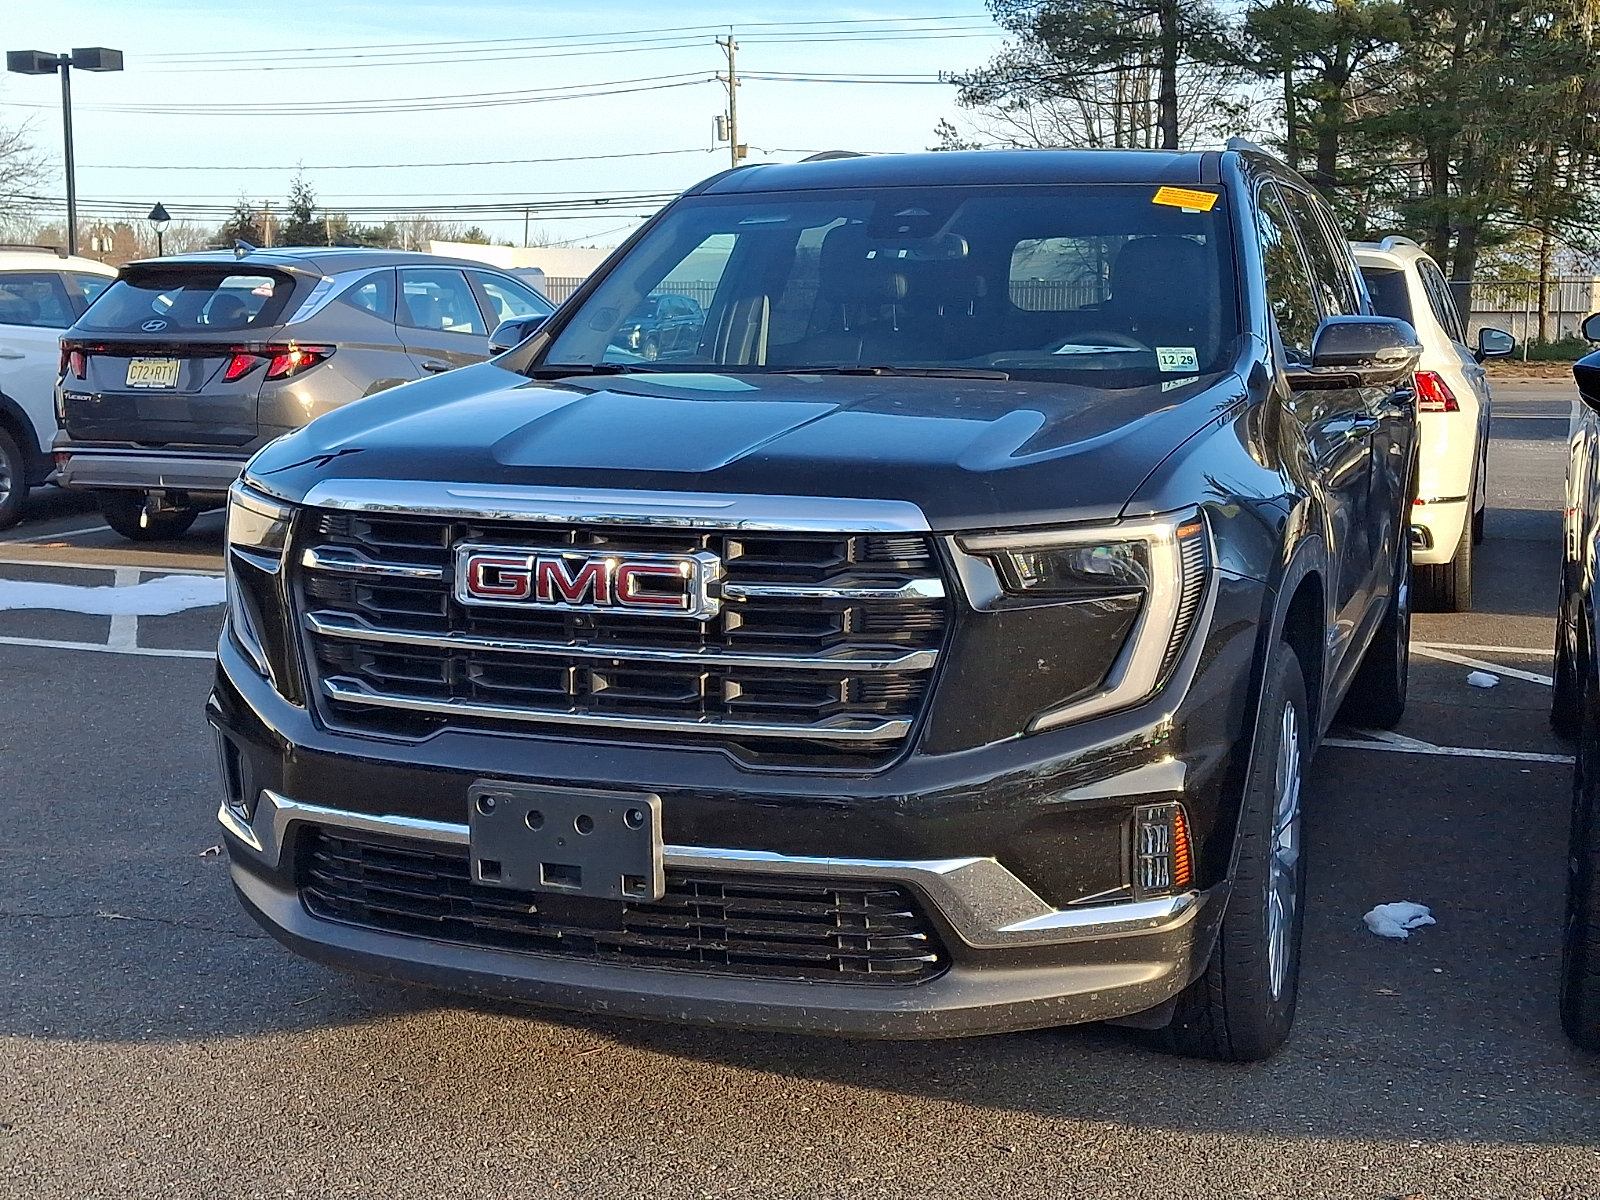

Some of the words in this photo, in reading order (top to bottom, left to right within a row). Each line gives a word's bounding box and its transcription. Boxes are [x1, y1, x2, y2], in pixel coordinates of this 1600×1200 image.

[1161, 355, 1176, 365] 12
[1180, 355, 1194, 365] 29
[467, 554, 691, 609] GMC
